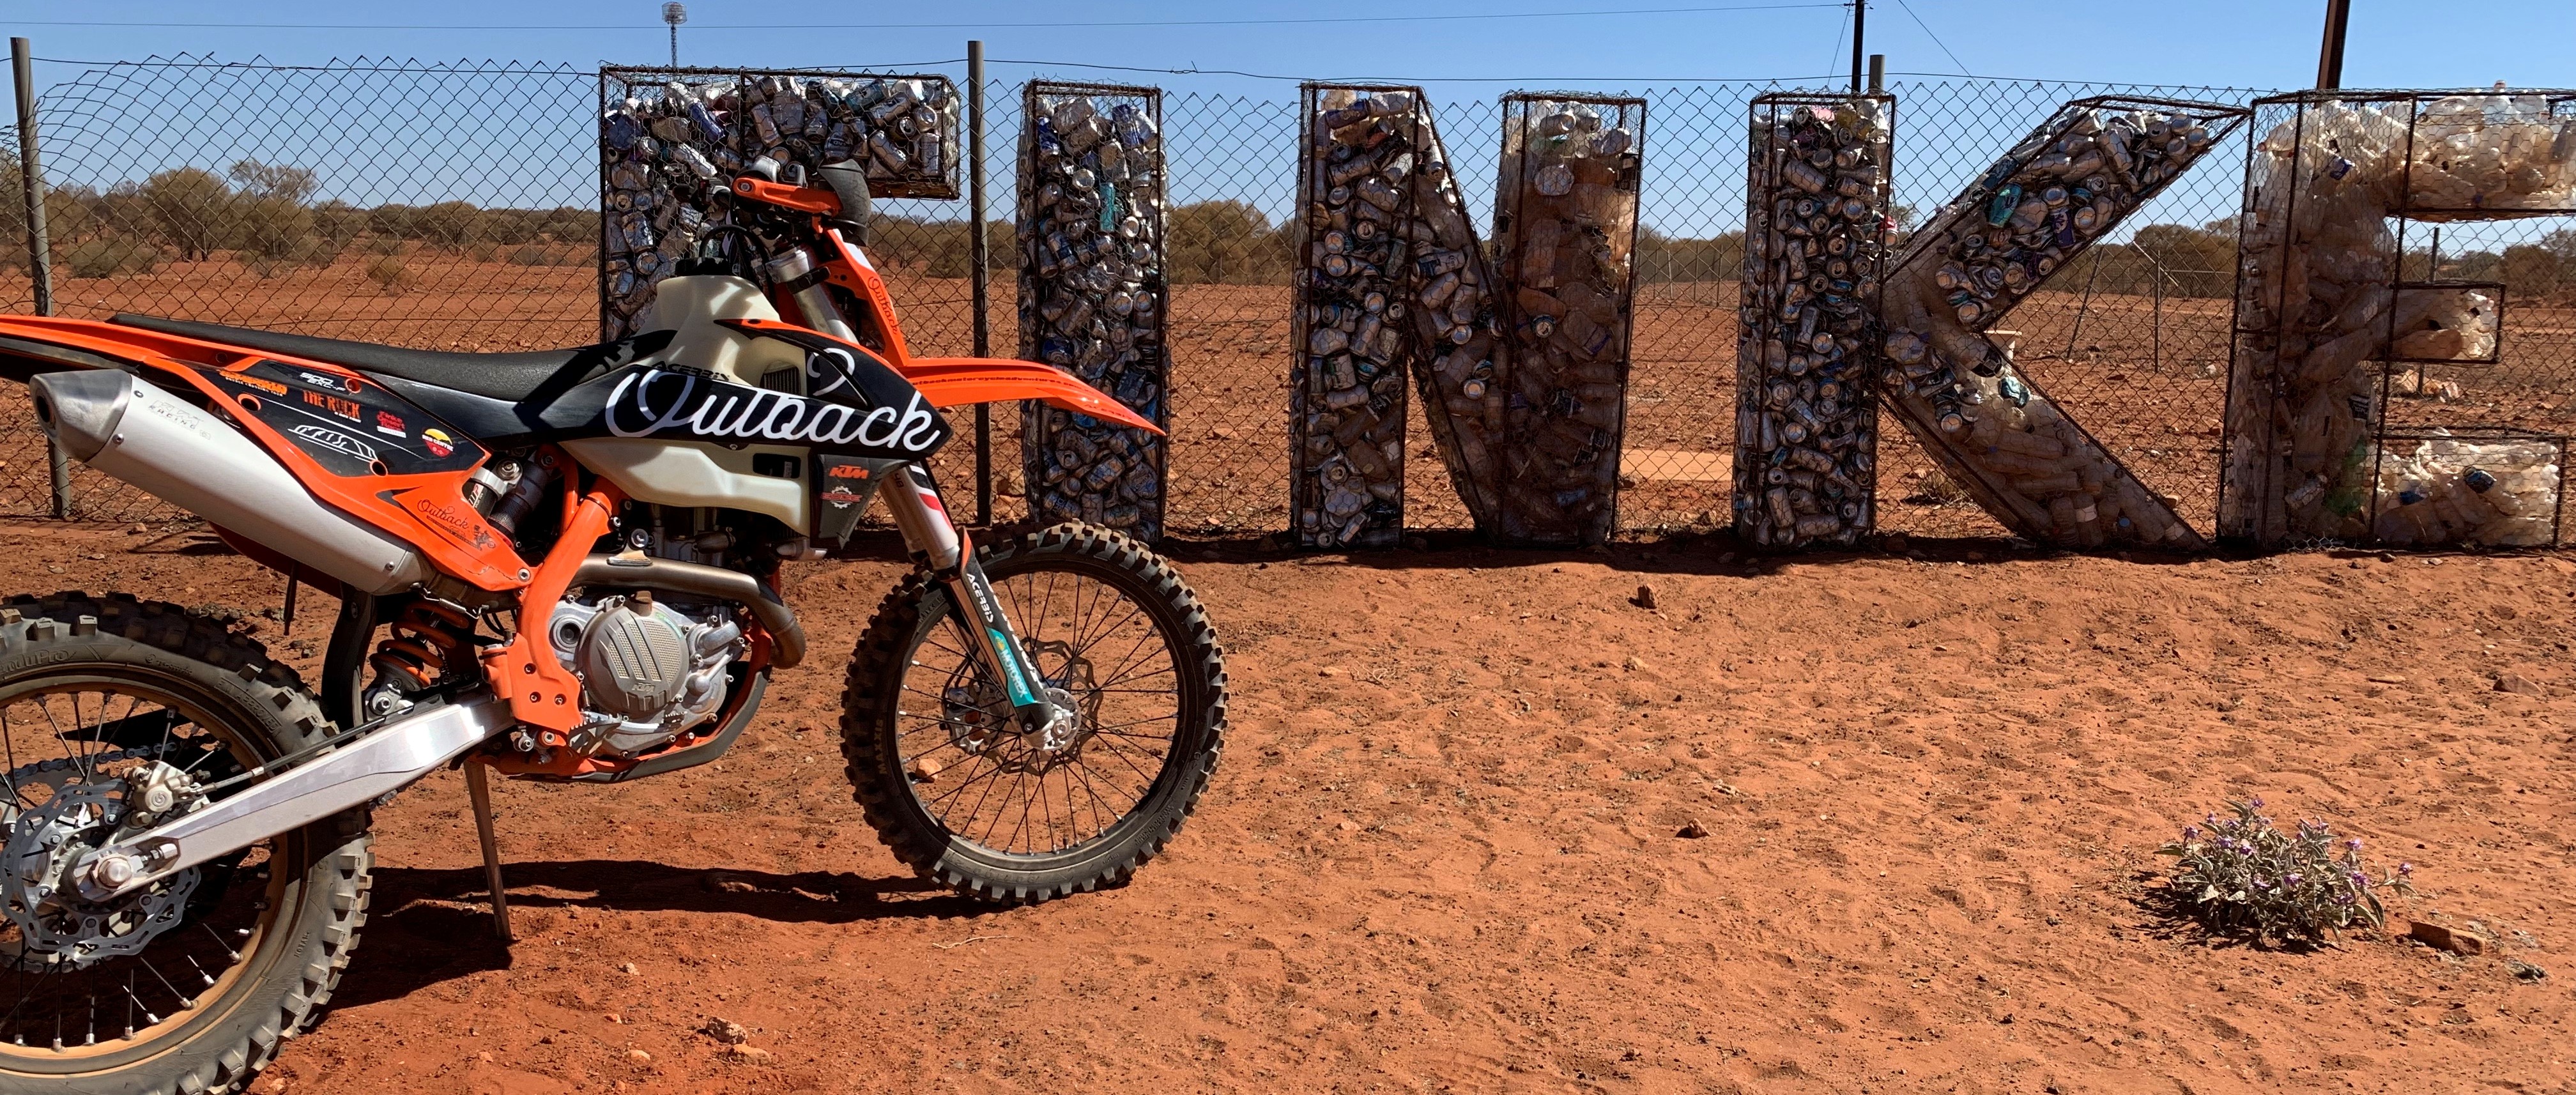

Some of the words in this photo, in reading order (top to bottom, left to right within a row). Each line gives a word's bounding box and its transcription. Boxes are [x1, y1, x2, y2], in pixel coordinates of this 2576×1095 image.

[868, 276, 897, 335] Outback
[300, 372, 334, 384] 500
[302, 389, 325, 408] THE
[326, 396, 362, 420] ROCK
[605, 348, 940, 451] Outback
[829, 464, 869, 479] KTM
[417, 499, 469, 530] Outback
[967, 572, 994, 624] ACERBIS
[631, 682, 656, 693] KTM
[1000, 648, 1028, 698] MOTOREX
[873, 718, 888, 775] MAXXIS
